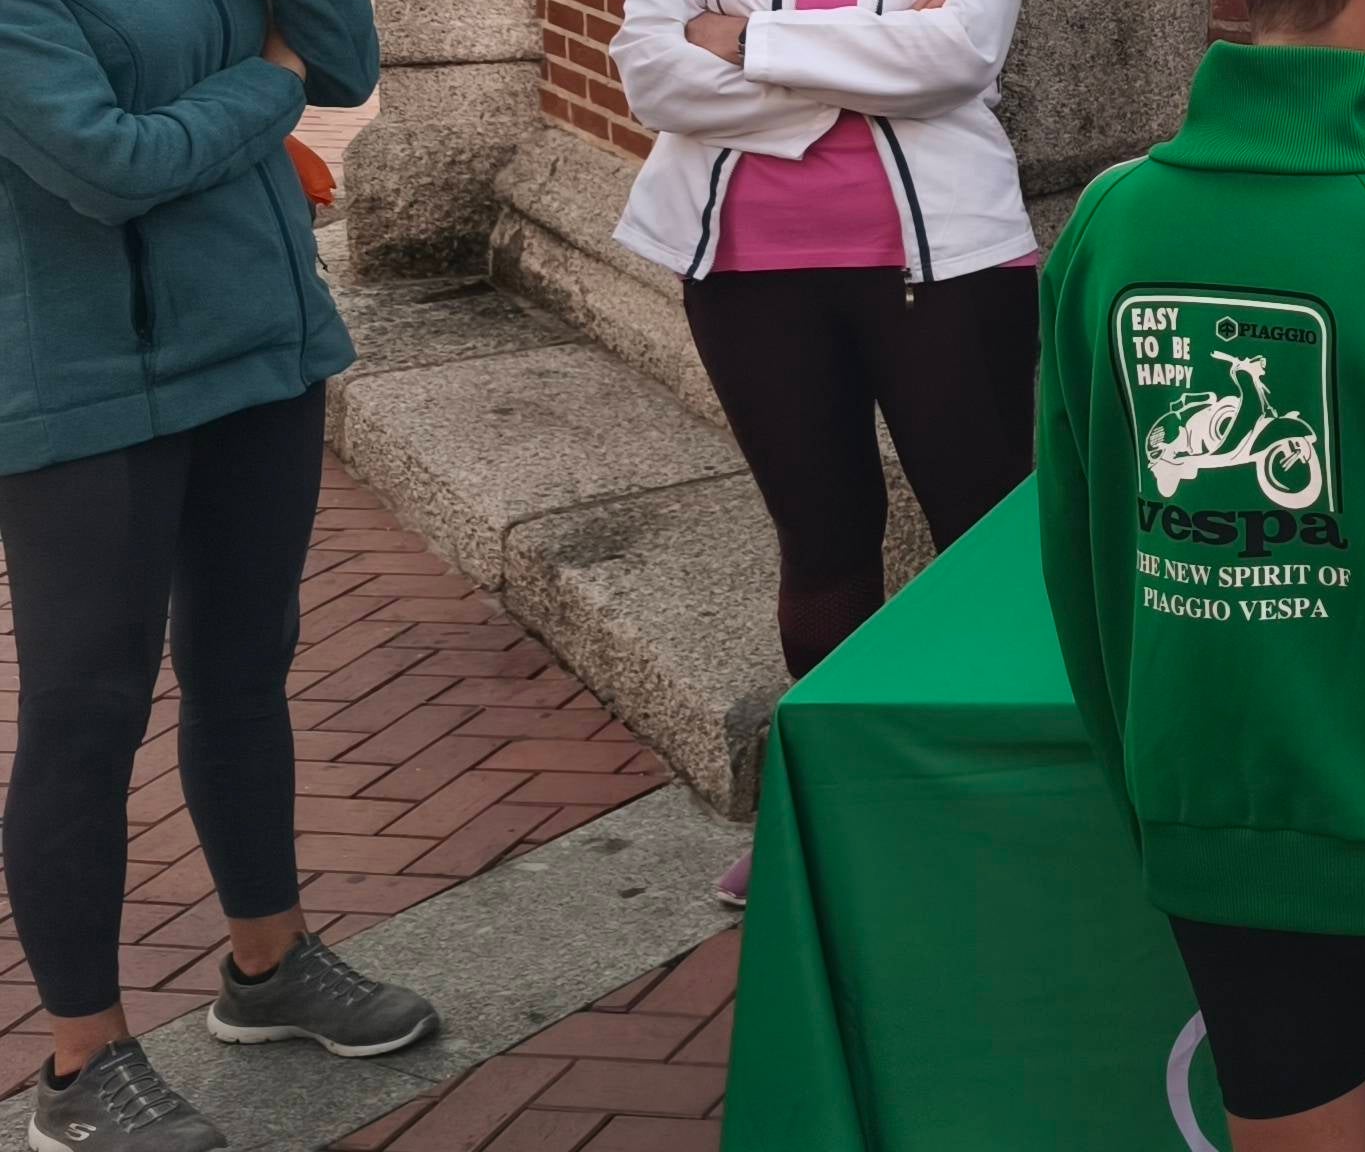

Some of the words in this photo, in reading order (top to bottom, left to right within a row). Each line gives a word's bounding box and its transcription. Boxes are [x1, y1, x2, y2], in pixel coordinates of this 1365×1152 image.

[1131, 307, 1179, 331] EASY
[1238, 323, 1317, 345] PIAGGIO
[1132, 335, 1160, 359] TO
[1172, 336, 1191, 361] BE
[1136, 363, 1194, 389] HAPPY
[1164, 559, 1212, 587] NEW
[1218, 564, 1311, 588] SPIRIT
[1318, 565, 1351, 588] OF
[1143, 586, 1231, 621] PIAGGIO
[1238, 598, 1329, 622] VESPA
